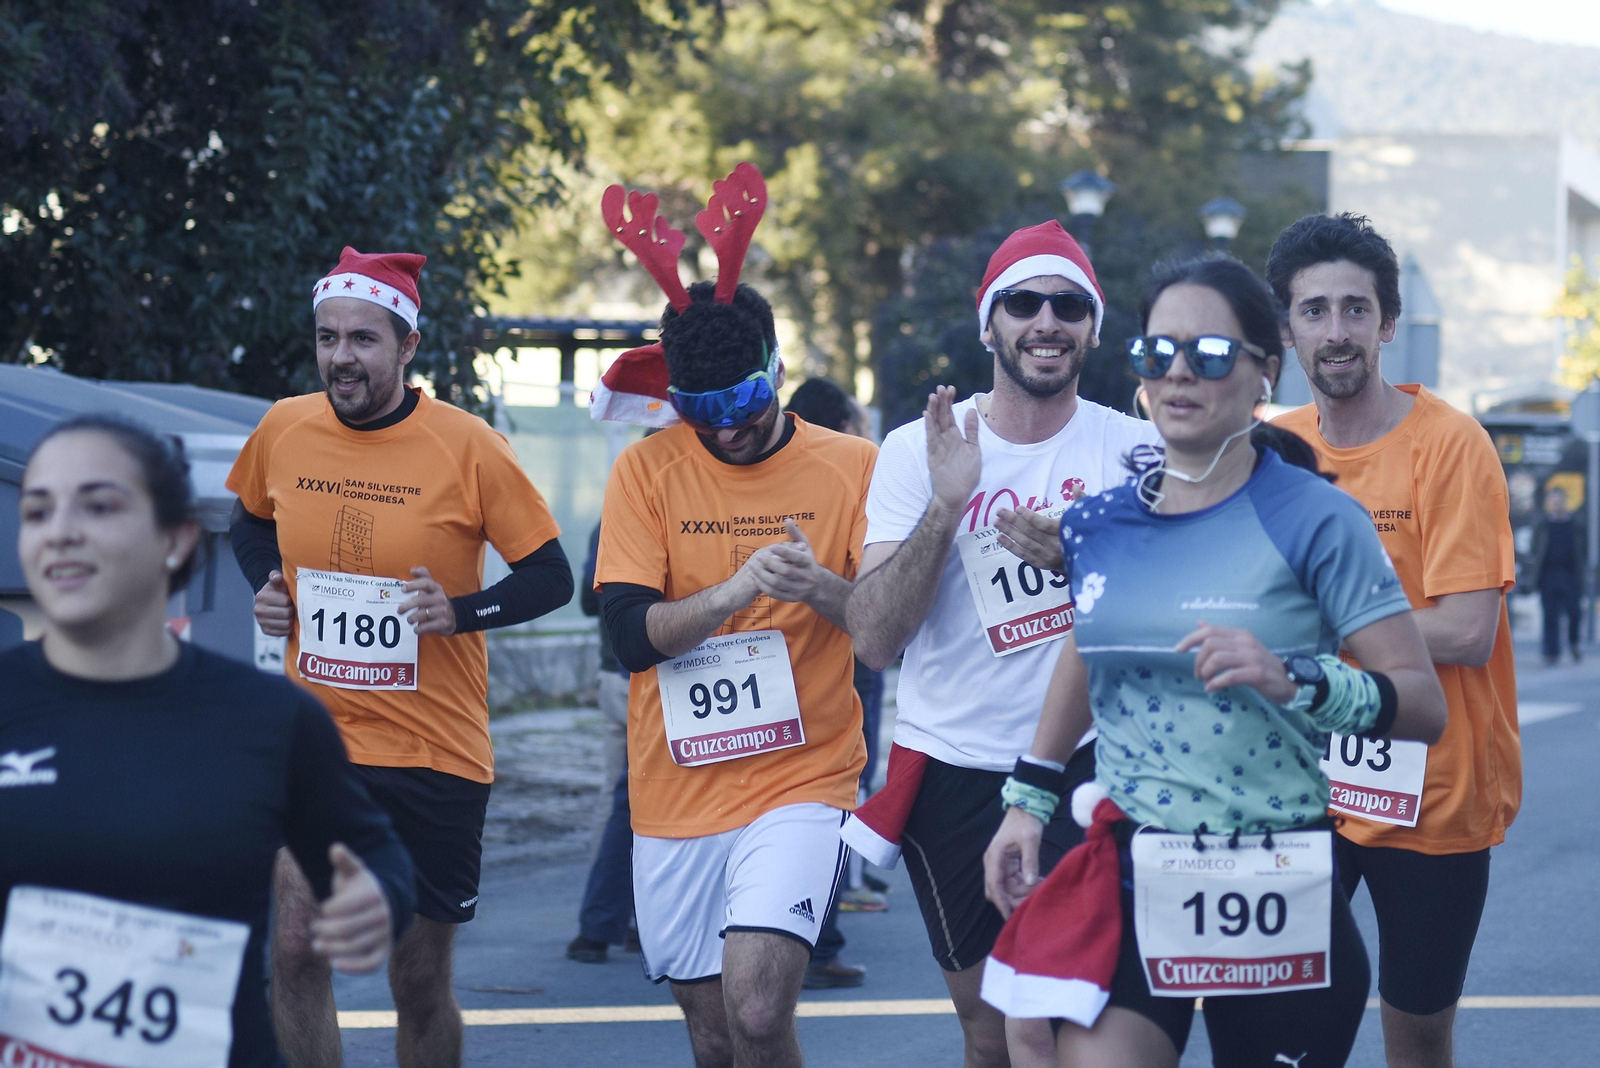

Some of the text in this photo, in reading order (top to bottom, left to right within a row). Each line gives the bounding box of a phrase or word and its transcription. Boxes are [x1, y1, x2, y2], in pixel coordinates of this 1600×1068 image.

[296, 477, 421, 496] XXXVI SAN SILVESTRE
[343, 490, 405, 505] CORDOBESA
[680, 512, 815, 534] XXXVI SAN SILVESTRE
[733, 525, 798, 537] CORDOBE
[974, 528, 1000, 540] XXXV
[333, 575, 344, 583] San
[344, 577, 369, 586] Silvestre
[321, 585, 355, 598] IMDECO
[311, 608, 401, 649] 1180
[999, 607, 1075, 644] Cruzcam
[735, 634, 771, 645] Cordobesa
[306, 655, 392, 685] Cruzcampo
[683, 654, 721, 669] IMDECO
[397, 667, 406, 681] SIN
[689, 673, 761, 719] 991
[782, 725, 793, 740] SIN
[680, 728, 777, 758] Cruzcampo
[1329, 785, 1392, 813] campo
[1397, 798, 1408, 816] SIN
[1160, 841, 1192, 850] XXXV
[1178, 859, 1236, 871] IMDECO
[1183, 891, 1287, 937] 190
[1157, 958, 1293, 987] Cruzcampo
[1302, 958, 1314, 978] SIN
[47, 968, 179, 1045] 349
